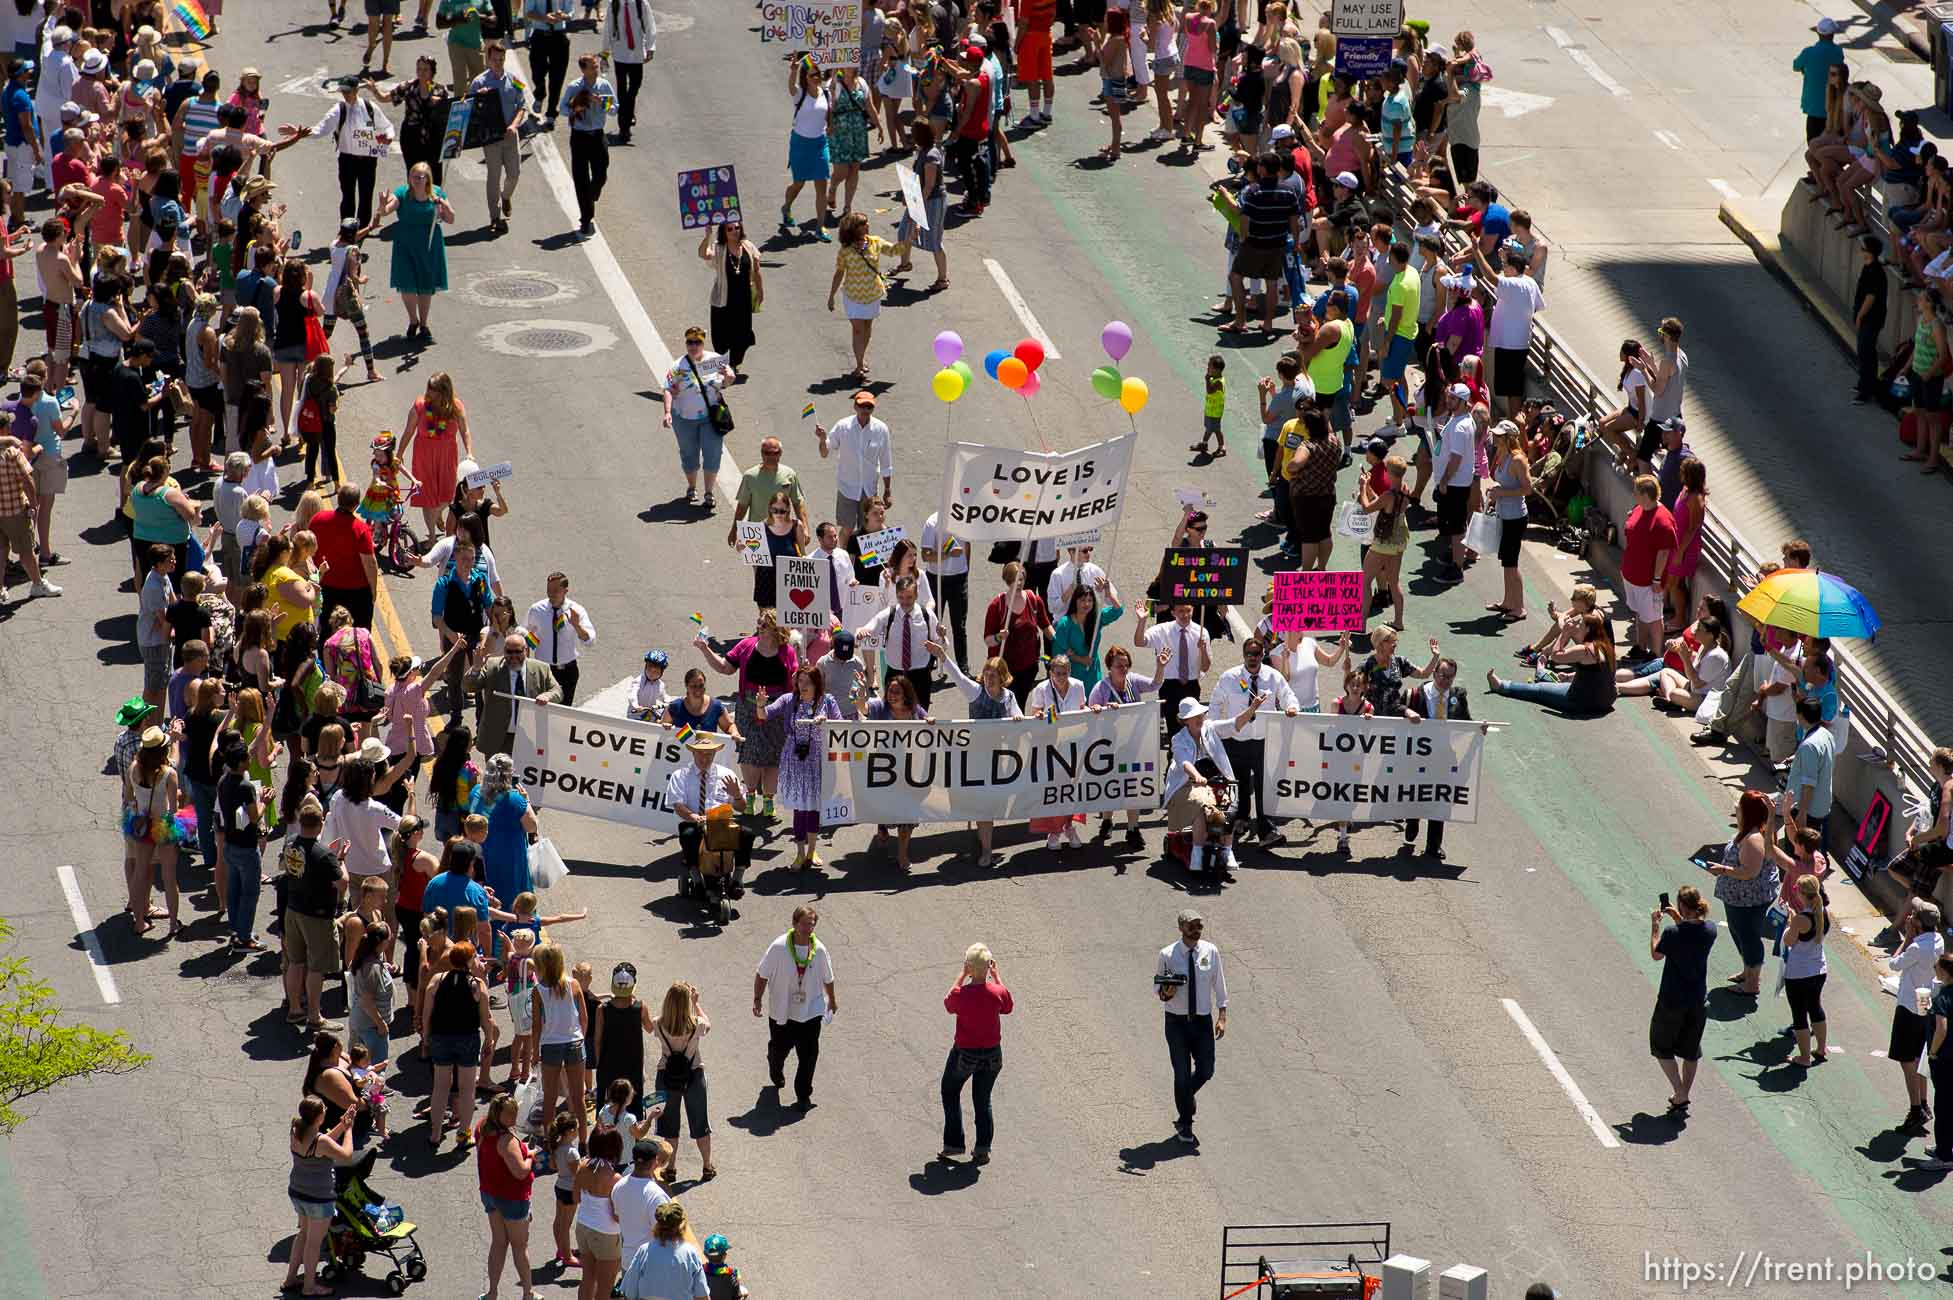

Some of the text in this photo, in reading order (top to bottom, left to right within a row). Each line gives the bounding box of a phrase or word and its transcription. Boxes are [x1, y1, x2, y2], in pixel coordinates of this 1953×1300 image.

[1343, 4, 1392, 14] MAY USE
[1336, 18, 1397, 28] FULL LANE
[1344, 52, 1380, 61] Friendly
[353, 129, 373, 140] god
[690, 184, 716, 198] ONE
[993, 460, 1095, 485] LOVE IS
[950, 492, 1118, 525] SPOKEN HERE
[742, 526, 762, 539] LDS
[745, 553, 769, 565] LGBT
[789, 560, 816, 574] PARK
[784, 574, 820, 588] FAMILY
[1293, 574, 1314, 585] WALK
[1318, 574, 1336, 584] WITH
[1293, 587, 1313, 599] TALK
[1317, 588, 1336, 599] WITH
[1307, 603, 1325, 614] HOW
[1342, 604, 1361, 615] SHOW
[1276, 618, 1294, 629] MY
[1329, 616, 1338, 630] 4
[569, 726, 681, 763] LOVE IS
[828, 728, 971, 749] MORMONS
[1319, 732, 1433, 756] LOVE IS
[867, 738, 1115, 788] BUILDING
[522, 766, 634, 804] SPOKEN
[1043, 777, 1155, 805] BRIDGES
[1276, 779, 1470, 805] SPOKEN HERE
[825, 805, 849, 819] 110
